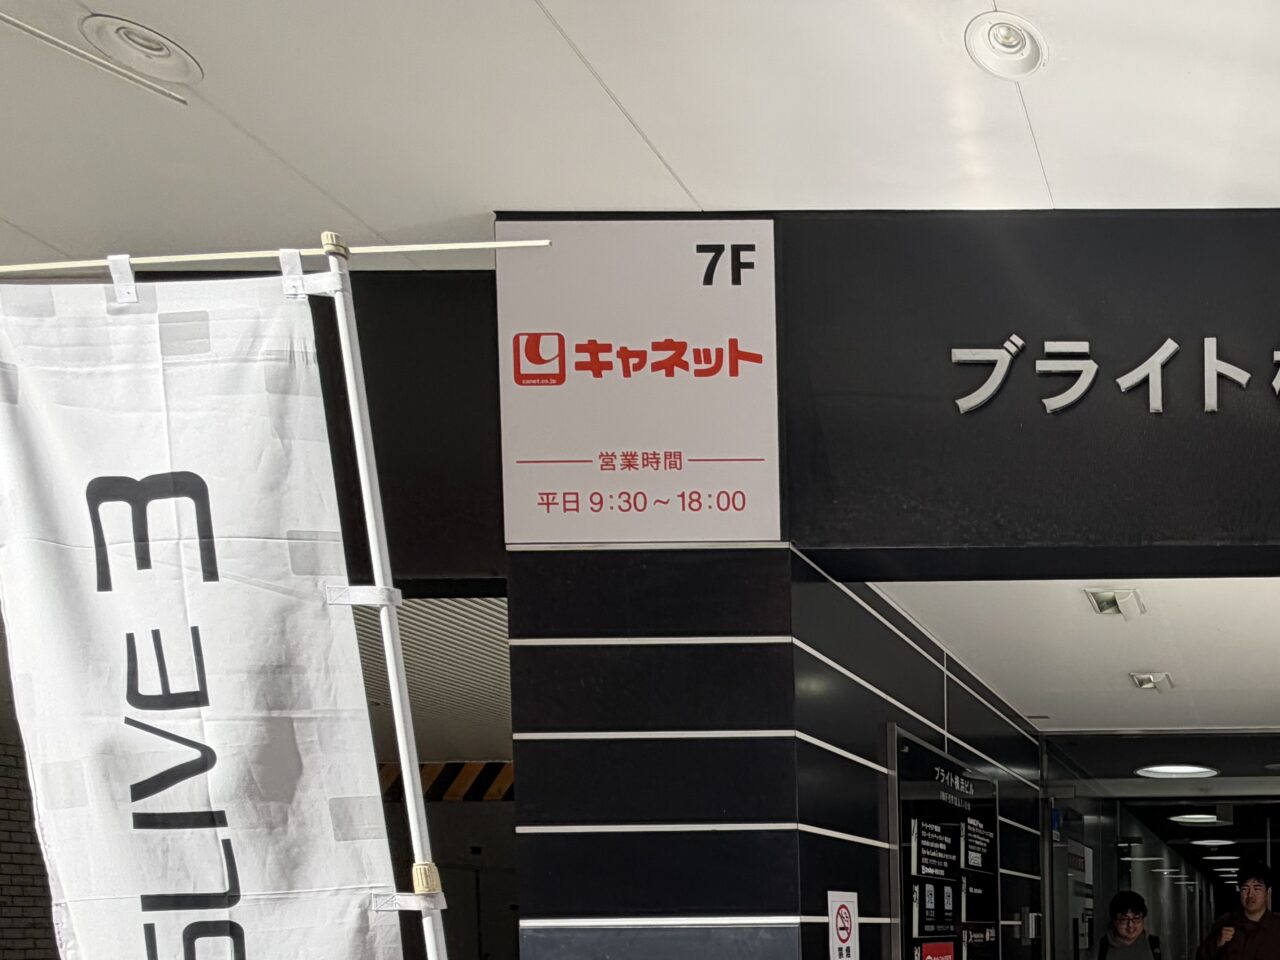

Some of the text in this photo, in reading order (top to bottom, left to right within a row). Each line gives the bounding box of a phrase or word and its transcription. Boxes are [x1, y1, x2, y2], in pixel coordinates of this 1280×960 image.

[696, 244, 756, 286] 7F
[574, 338, 764, 379] キャネット
[598, 450, 683, 472] 営業時間
[537, 491, 580, 514] 平日
